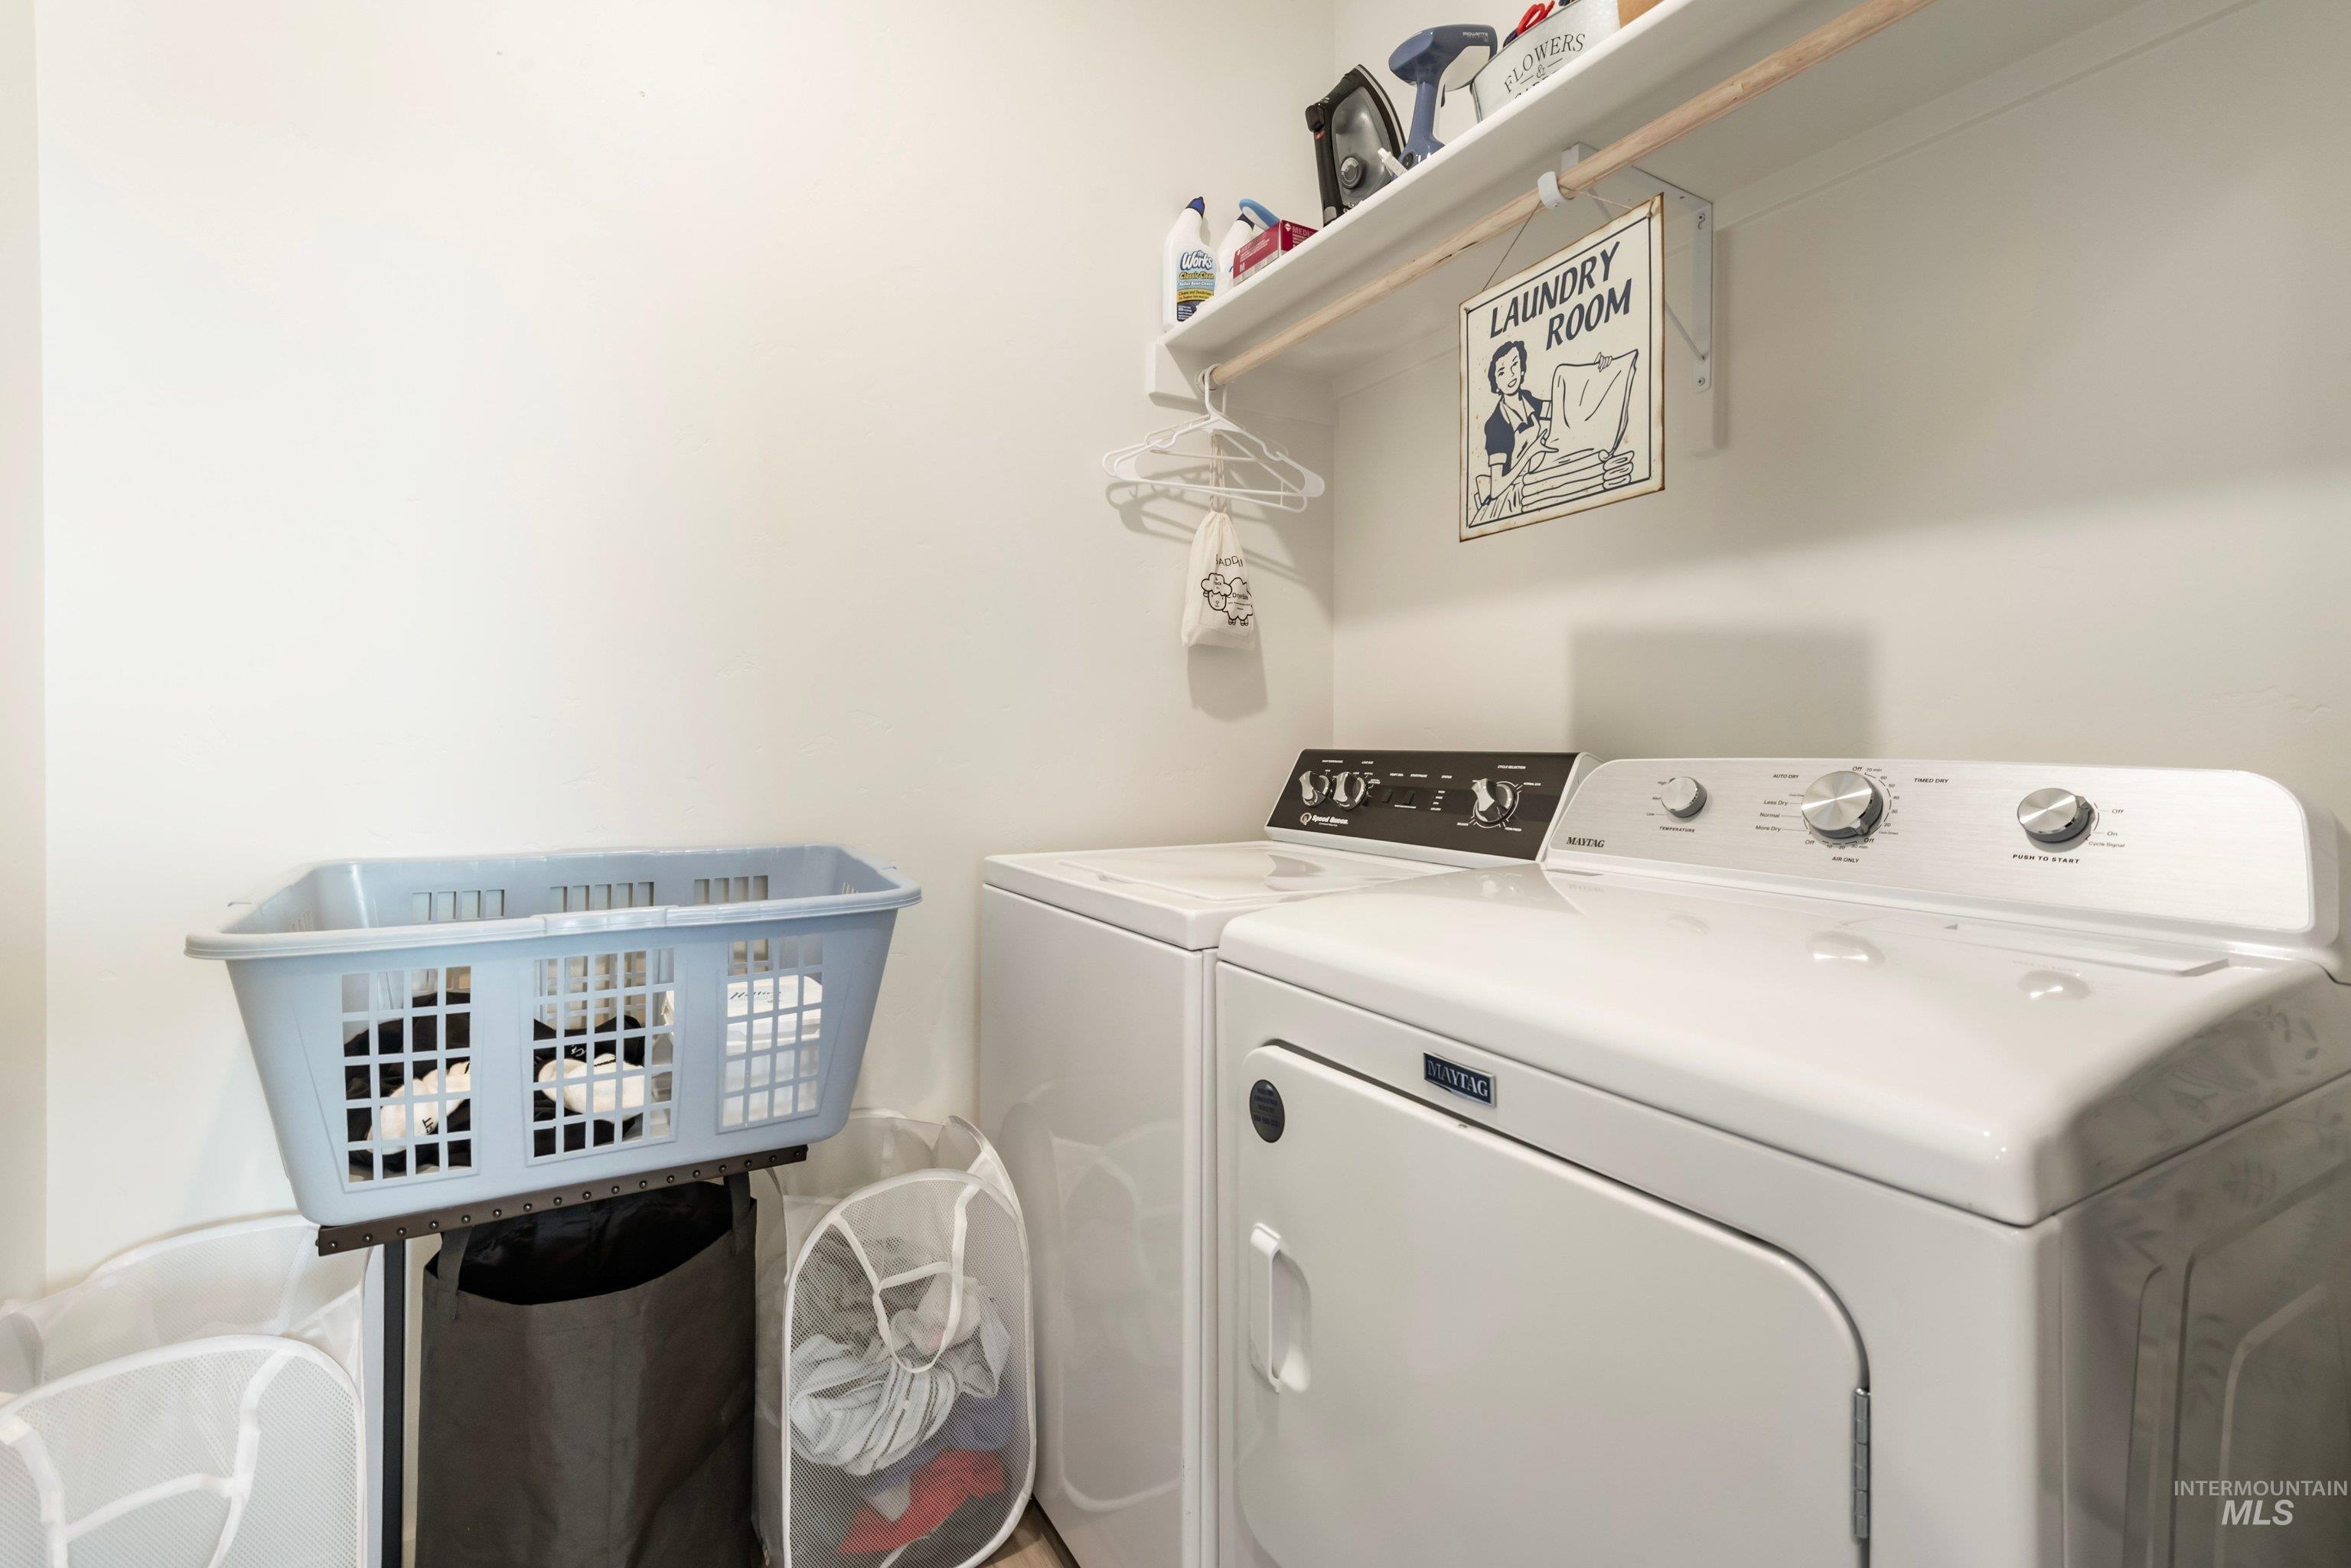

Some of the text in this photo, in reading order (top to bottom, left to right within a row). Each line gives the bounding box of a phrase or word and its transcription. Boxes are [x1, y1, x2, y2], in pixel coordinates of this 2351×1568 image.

[1504, 34, 1586, 94] FLOWERS
[1536, 64, 1547, 78] &
[1181, 252, 1213, 271] Works
[1179, 271, 1215, 280] Classic Clean
[1490, 241, 1621, 338] LAUNDRY
[1545, 278, 1632, 350] ROOM
[1312, 814, 1330, 823] Speed
[1566, 836, 1605, 848] MAYTAG
[1427, 1061, 1488, 1097] MAYTAG
